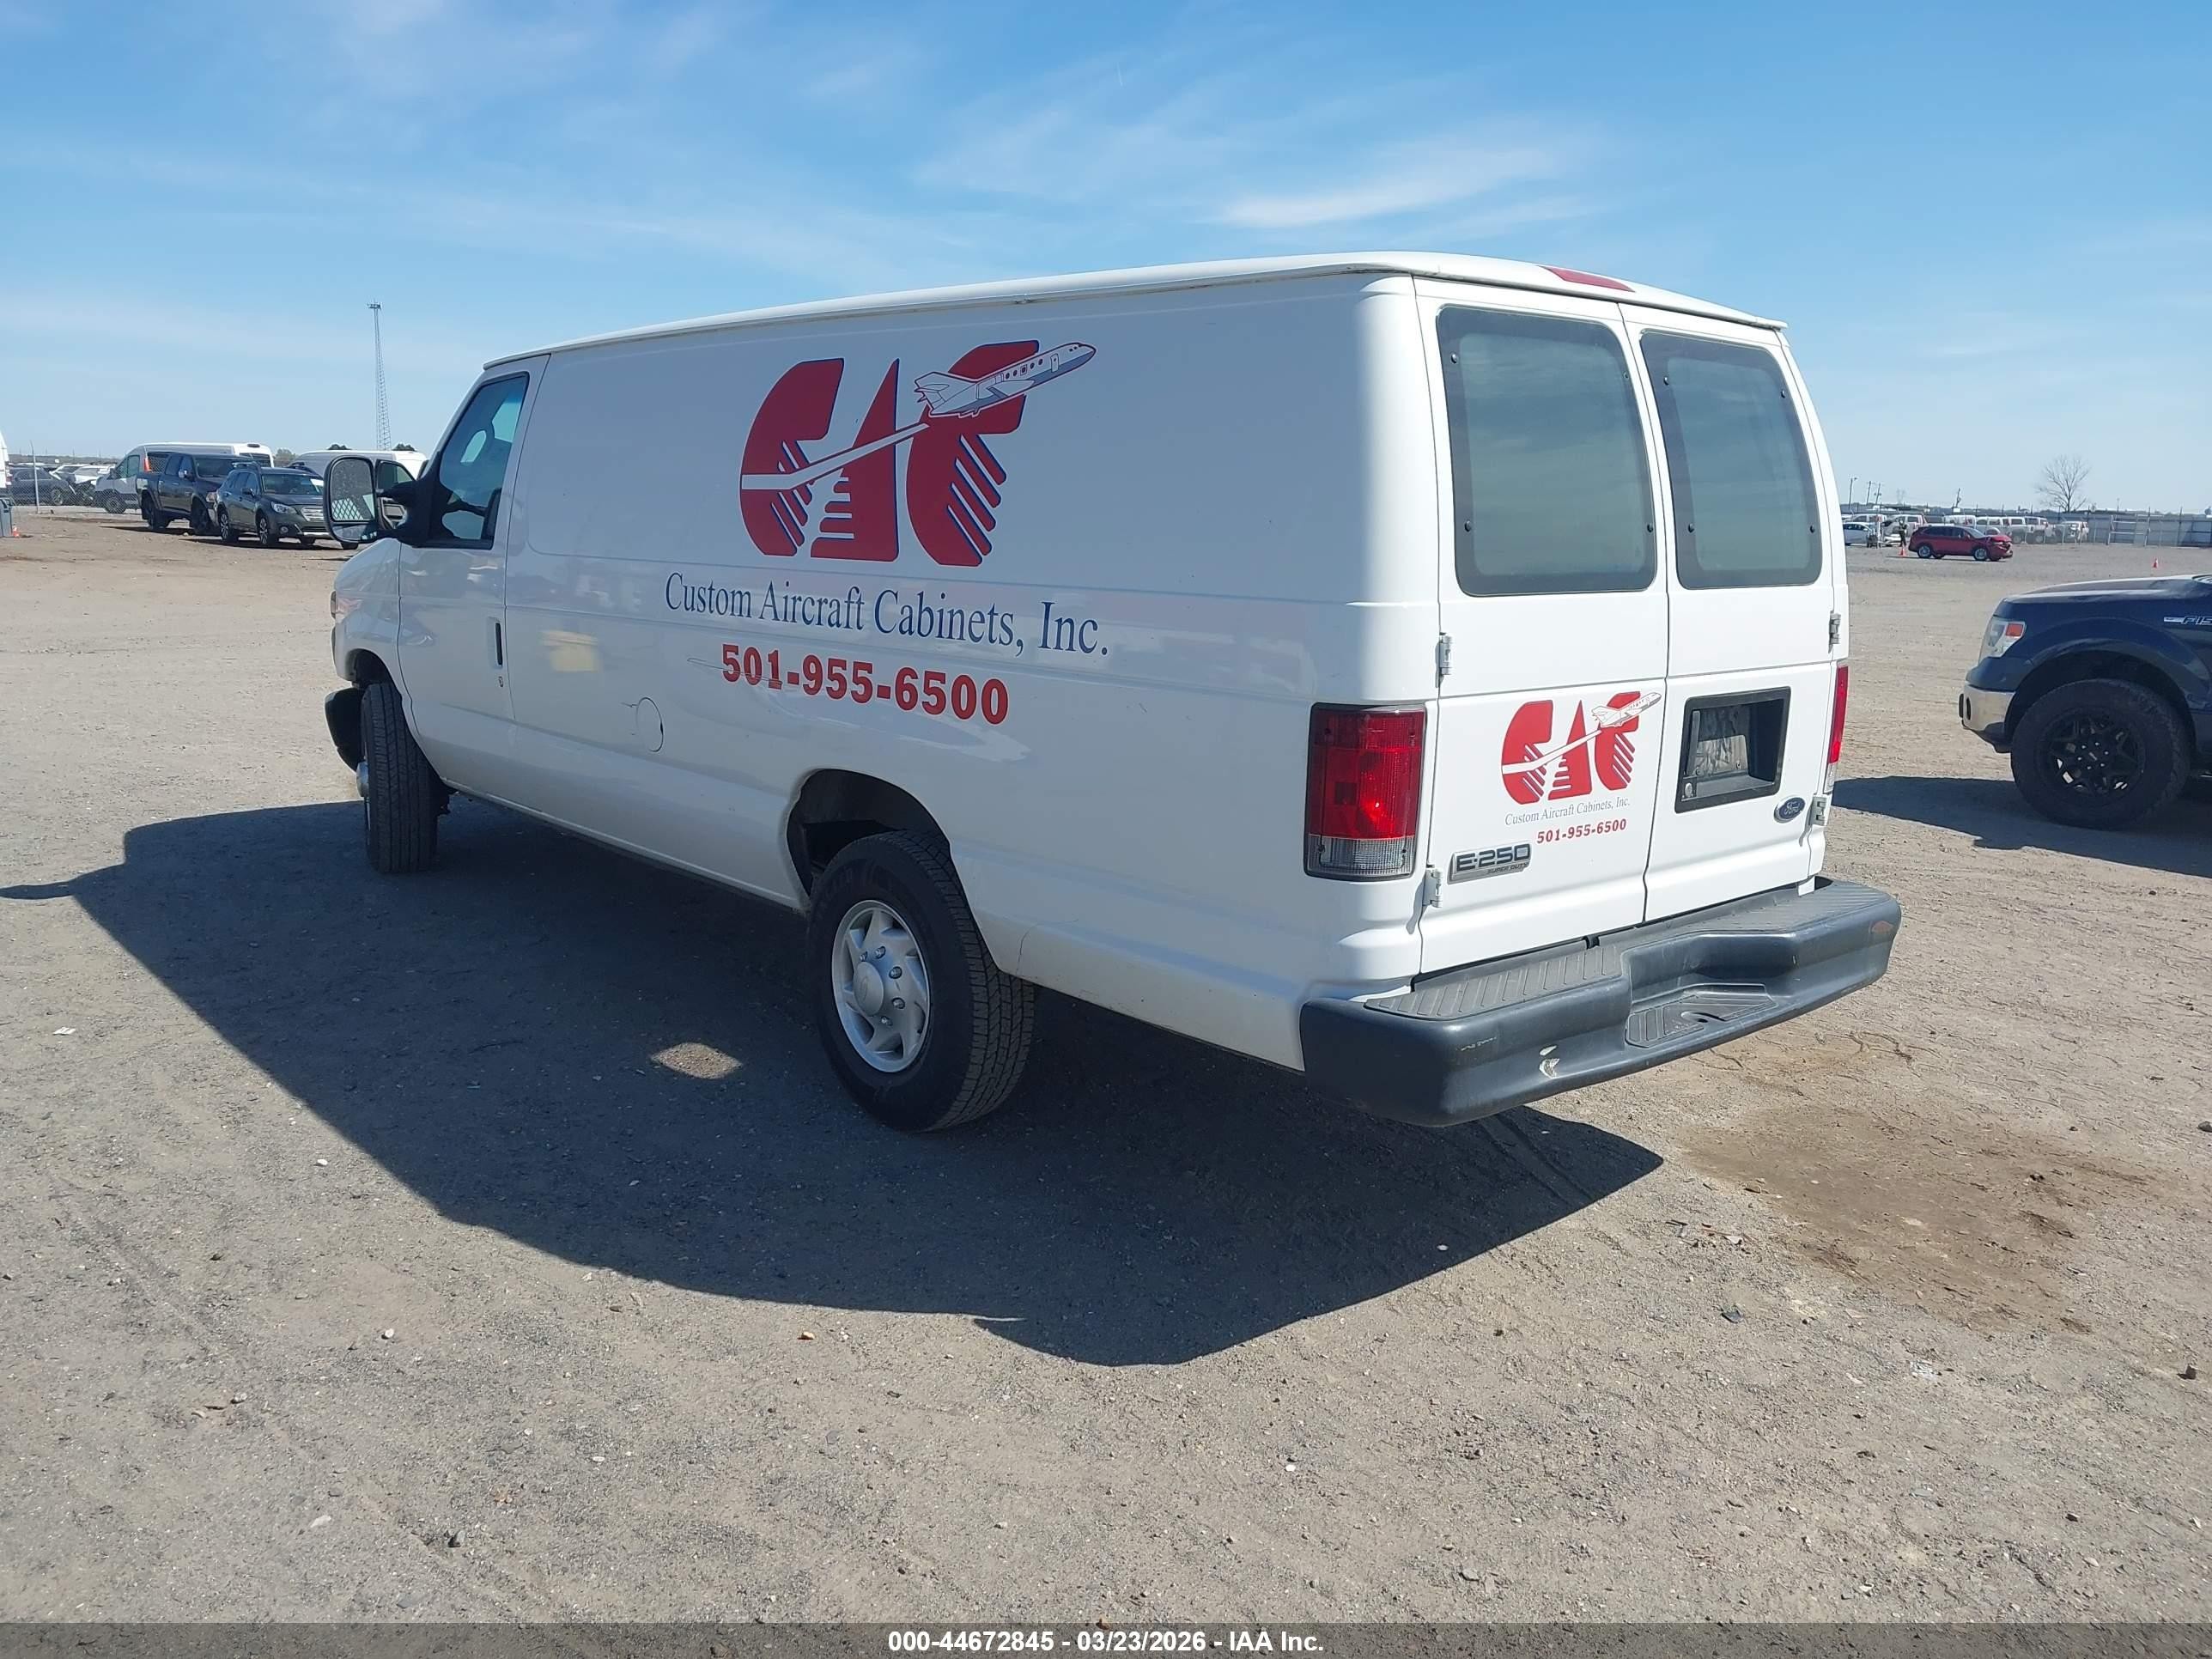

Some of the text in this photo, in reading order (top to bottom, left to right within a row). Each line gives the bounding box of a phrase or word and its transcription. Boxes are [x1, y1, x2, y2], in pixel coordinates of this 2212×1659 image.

[665, 572, 1109, 657] Custom Aircraft Cabinets, Inc.
[721, 644, 1009, 725] 501-955-6500
[1504, 796, 1631, 826] Custom Aircraft Cabinets, Inc.
[1536, 818, 1627, 844] 501-955-6500
